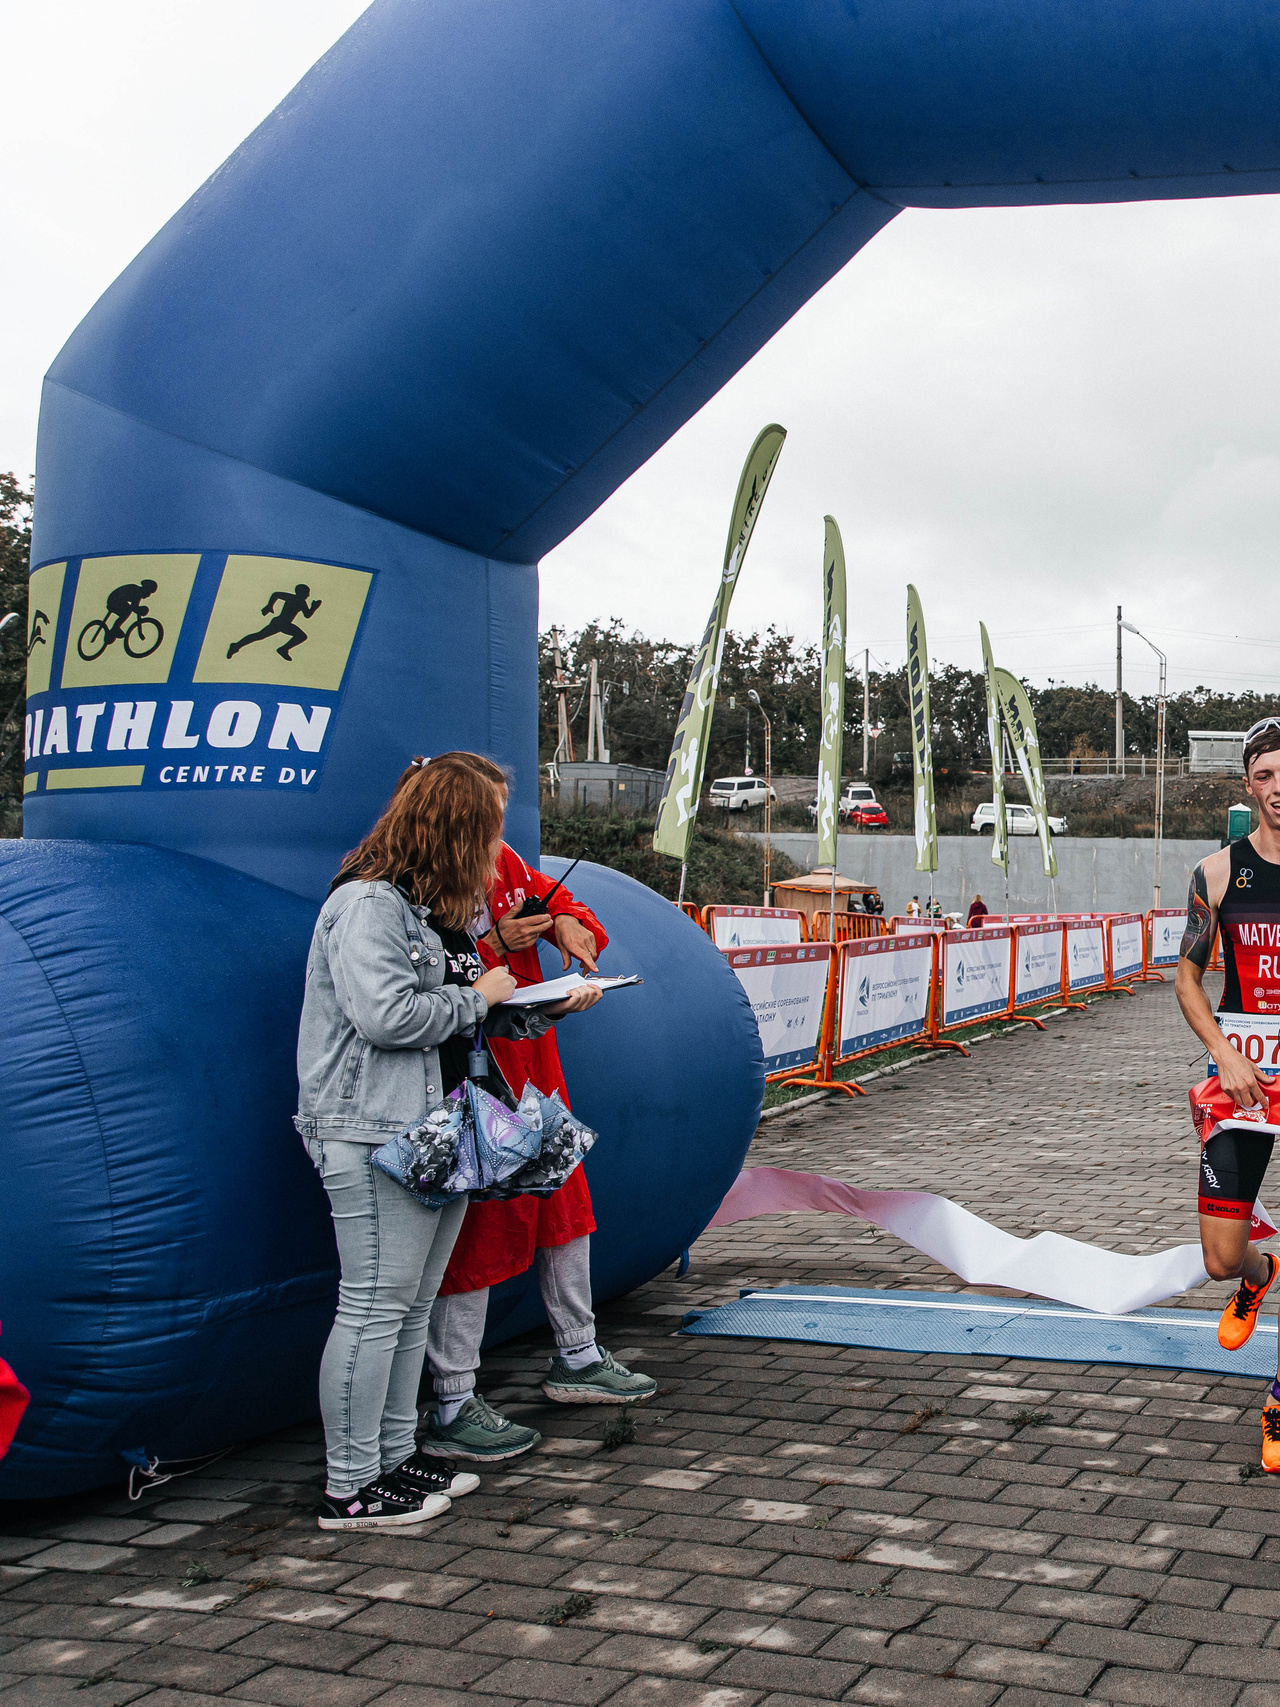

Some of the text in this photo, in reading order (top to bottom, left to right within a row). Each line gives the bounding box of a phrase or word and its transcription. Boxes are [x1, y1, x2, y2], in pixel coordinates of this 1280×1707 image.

[25, 700, 332, 761] RIATHLON
[159, 765, 317, 785] CENTRE DV
